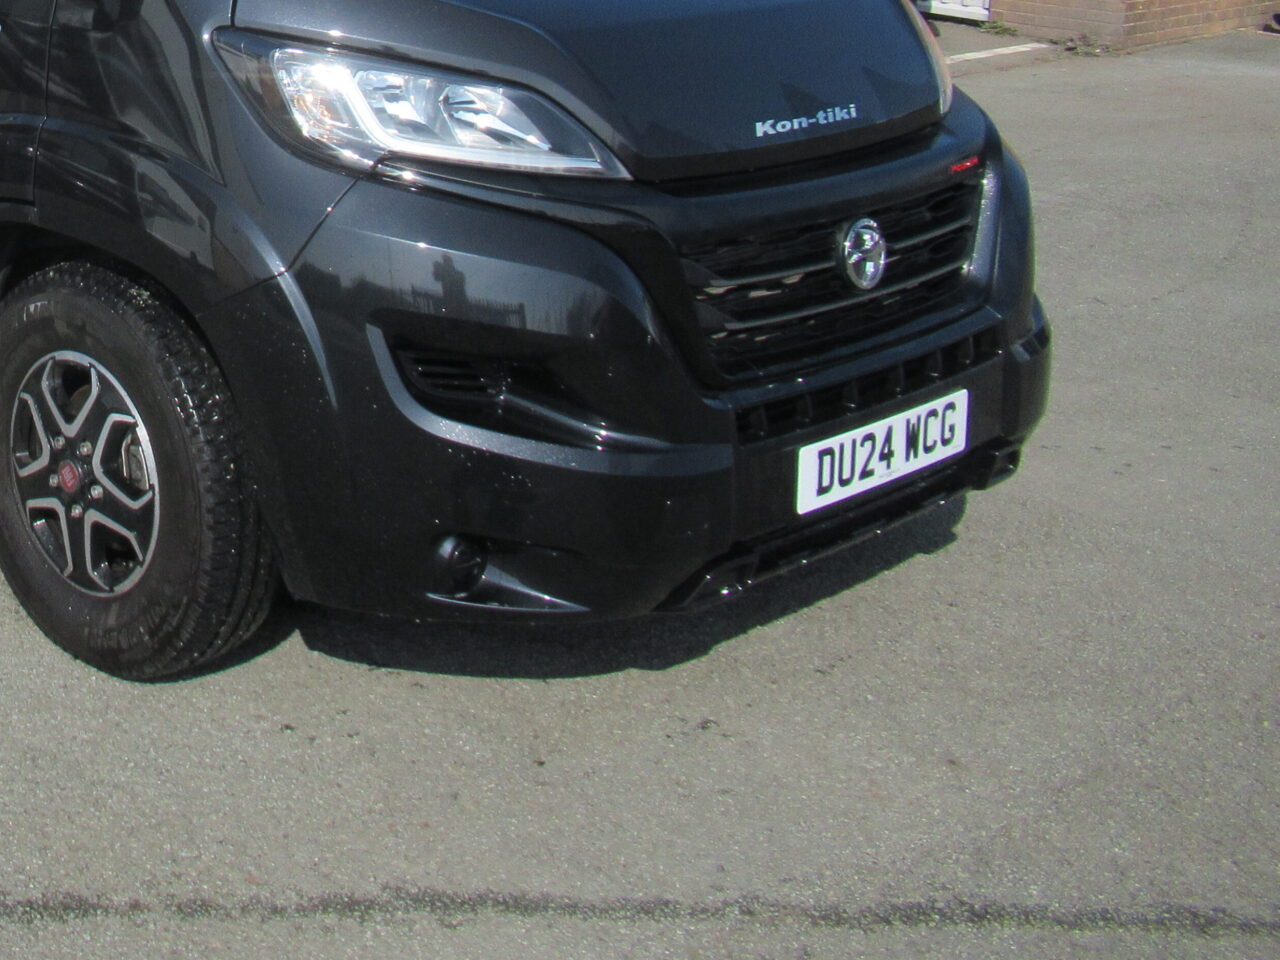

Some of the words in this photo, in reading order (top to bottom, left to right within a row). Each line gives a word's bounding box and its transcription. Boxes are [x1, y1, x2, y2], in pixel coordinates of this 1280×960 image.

[755, 103, 857, 138] Kon-tiki
[816, 425, 895, 497] DU24
[905, 401, 957, 462] WCG
